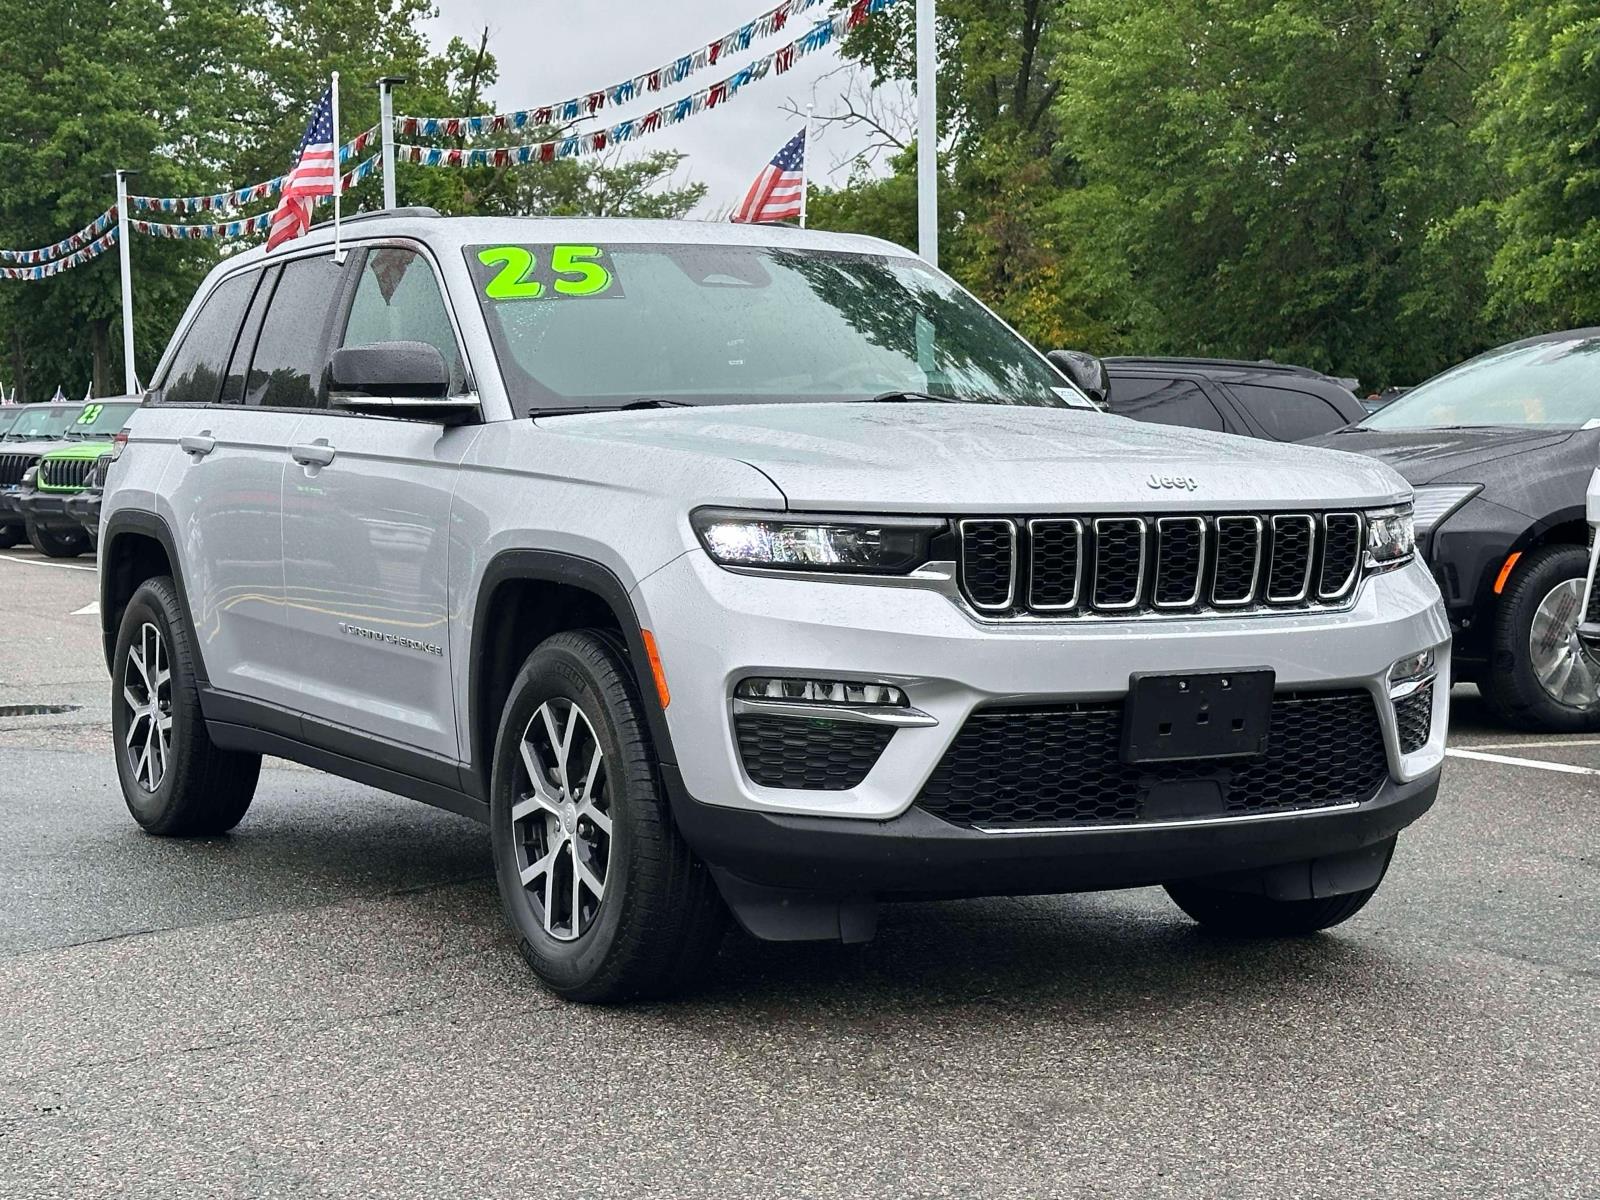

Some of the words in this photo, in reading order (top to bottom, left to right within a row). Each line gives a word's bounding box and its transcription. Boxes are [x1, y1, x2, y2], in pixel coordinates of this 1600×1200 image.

[477, 244, 614, 300] 25
[77, 404, 104, 425] 23
[1146, 474, 1198, 492] Jeep
[386, 633, 443, 656] CHEROKEE
